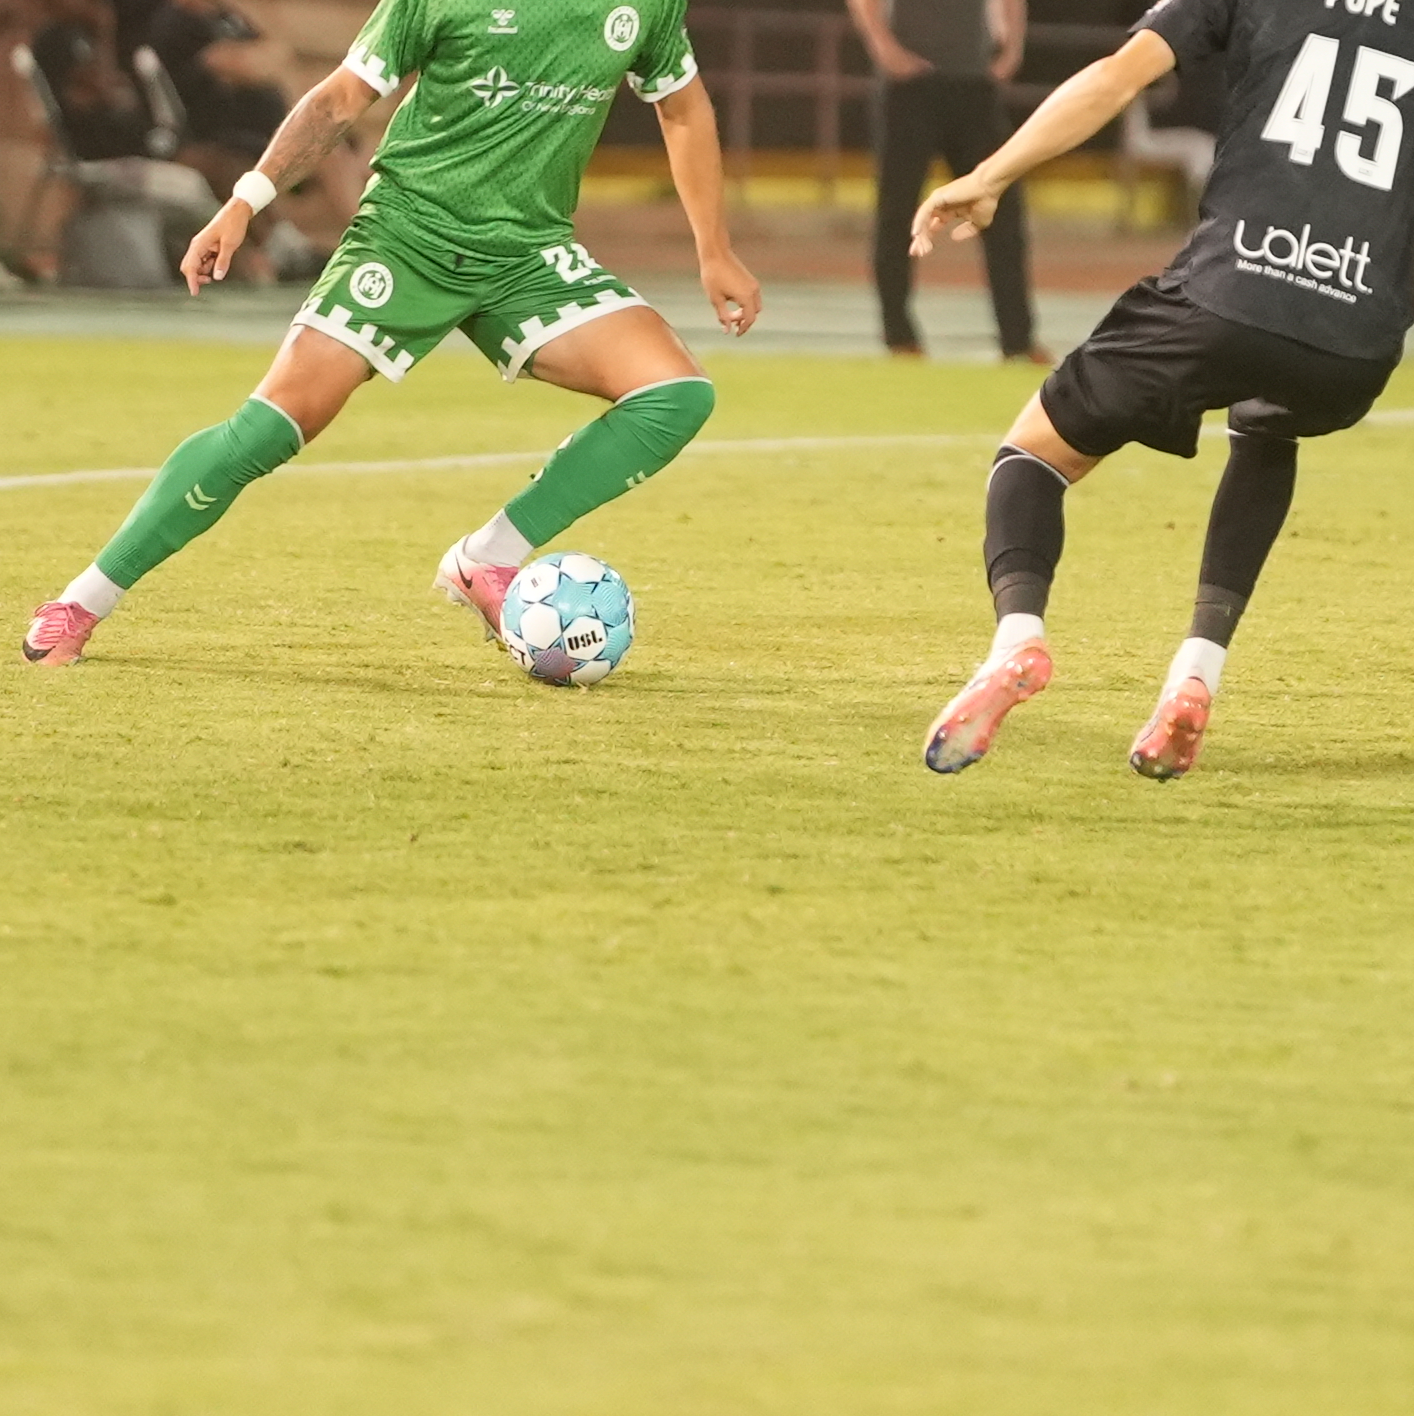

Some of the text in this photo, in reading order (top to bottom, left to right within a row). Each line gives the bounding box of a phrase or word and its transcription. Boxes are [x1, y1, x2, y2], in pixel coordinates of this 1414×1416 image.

[525, 81, 577, 104] Trinity
[1236, 259, 1358, 305] More than a cash advance
[567, 629, 603, 651] USL
